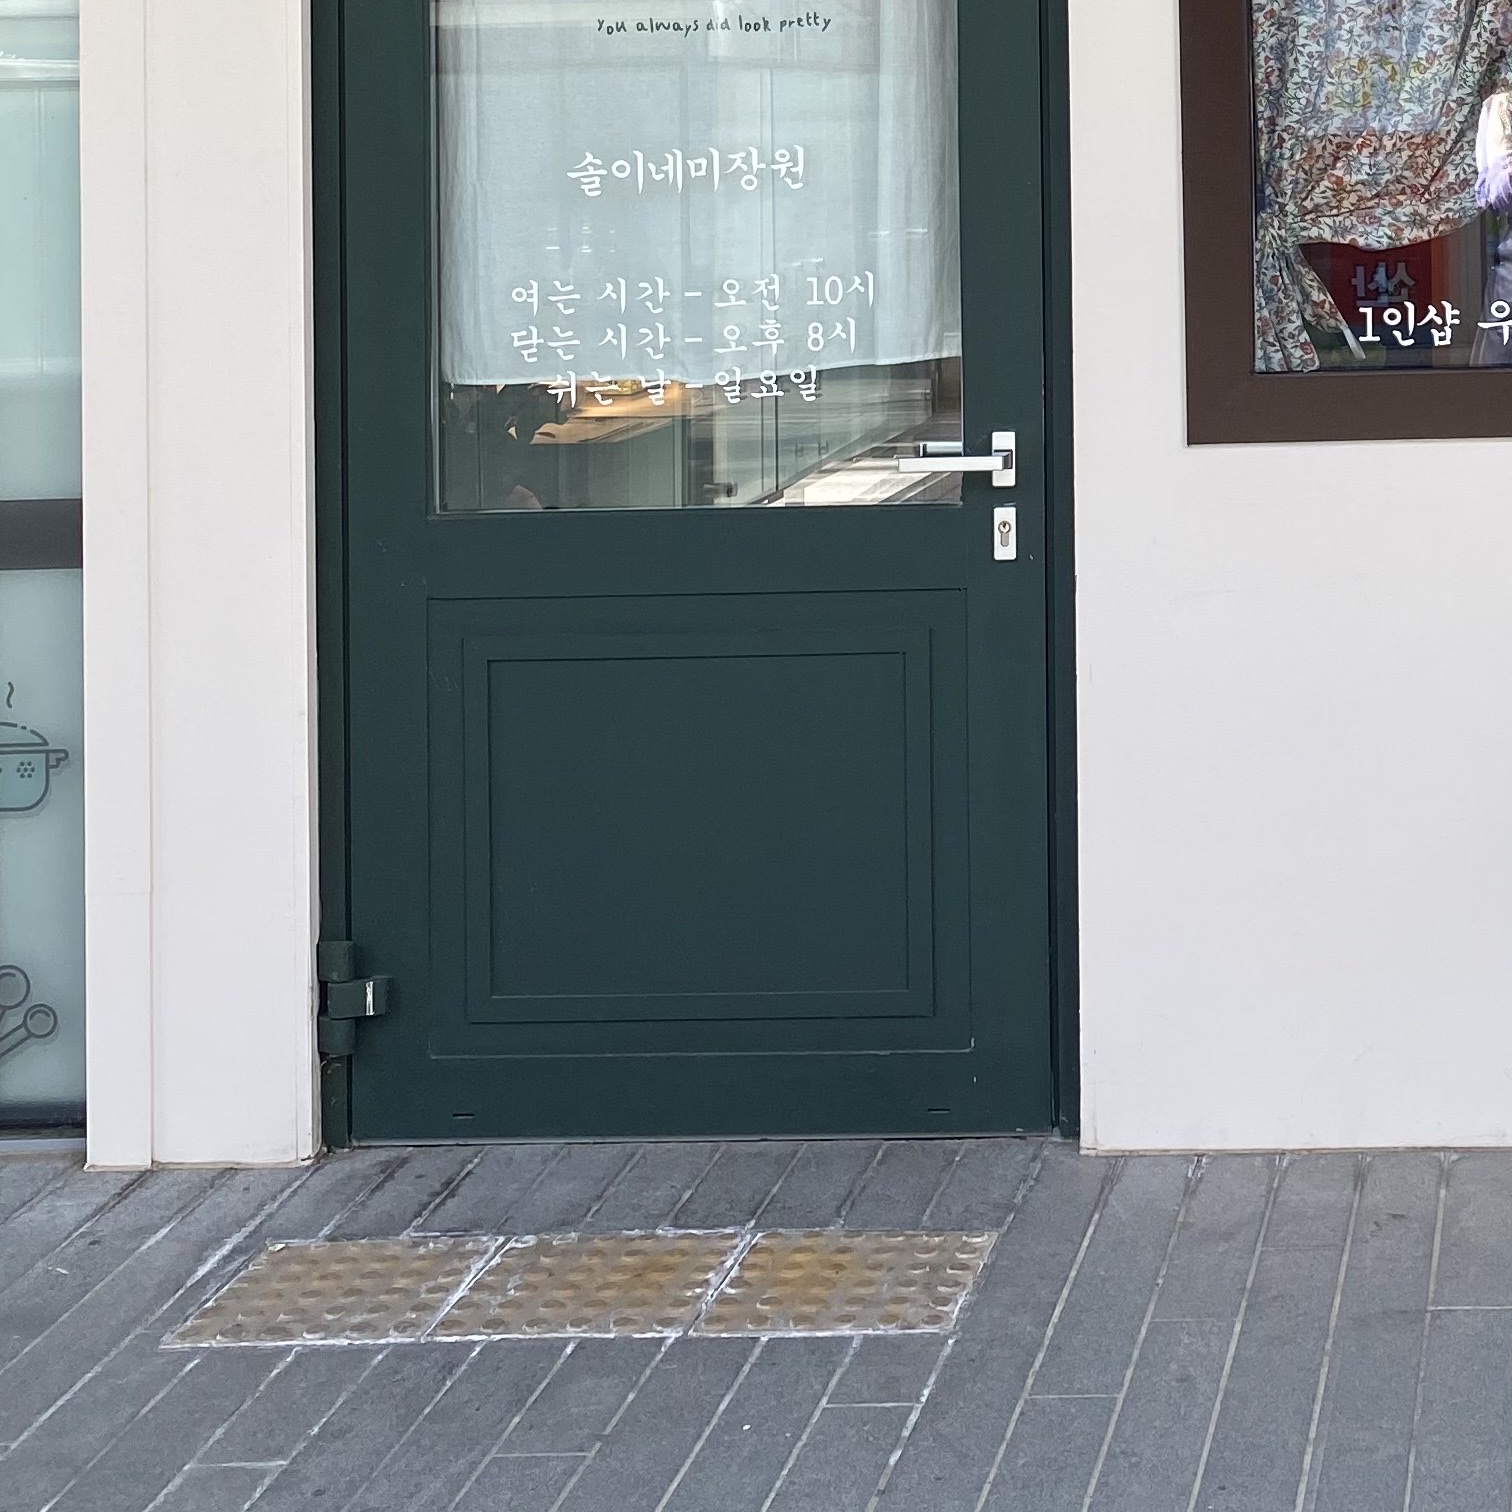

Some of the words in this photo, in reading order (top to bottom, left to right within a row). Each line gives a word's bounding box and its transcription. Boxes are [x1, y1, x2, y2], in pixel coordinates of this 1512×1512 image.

[636, 17, 699, 39] always
[706, 18, 731, 31] did
[738, 14, 772, 32] look
[779, 11, 832, 33] pretty
[511, 279, 582, 317] 여는
[597, 276, 671, 315] 시간
[714, 273, 782, 312] 오전
[805, 270, 874, 308] 10시
[511, 324, 582, 363] 닫는
[597, 322, 671, 361] 시간
[714, 318, 785, 358] 오후
[806, 316, 857, 355] 8시
[1358, 300, 1461, 347] 1인샵
[547, 370, 622, 409] 쉬는
[637, 368, 673, 405] 날
[713, 364, 819, 405] 일요일
